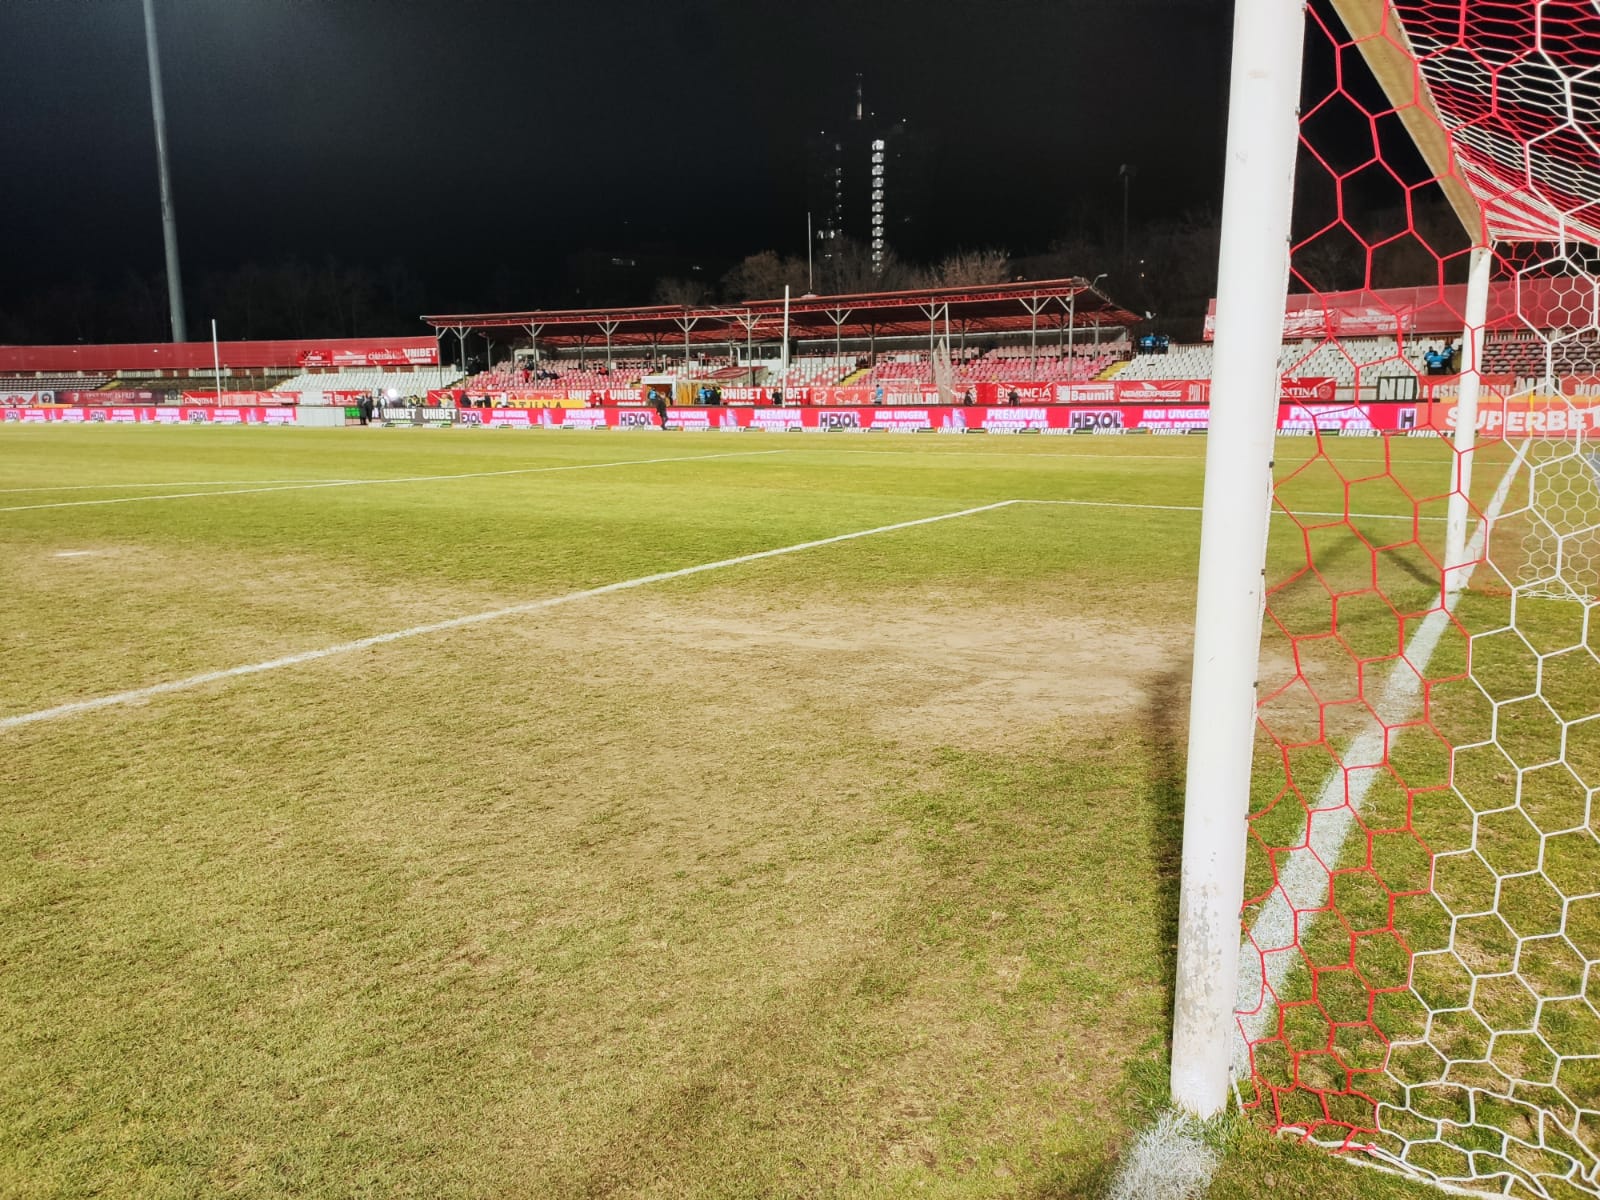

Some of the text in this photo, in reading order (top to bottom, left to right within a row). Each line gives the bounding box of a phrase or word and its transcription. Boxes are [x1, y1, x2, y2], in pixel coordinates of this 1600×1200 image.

[403, 347, 437, 357] UNIBET
[721, 388, 762, 399] UNIBET
[1071, 390, 1114, 401] Baumit
[384, 408, 416, 419] UNIBET
[422, 408, 457, 420] UNIBET
[754, 409, 801, 419] PREMIUM
[987, 409, 1047, 420] PREMIUM
[1143, 410, 1166, 419] NOI
[1290, 405, 1369, 419] PREMIUM
[620, 413, 652, 425] HEXOL
[820, 413, 858, 427] HEXOL
[1071, 412, 1122, 428] HEXOL
[1040, 427, 1076, 435] UNIBET
[1092, 426, 1129, 435] UNIBET
[1152, 427, 1191, 435] UNIBET
[1407, 430, 1453, 438] UNIBET
